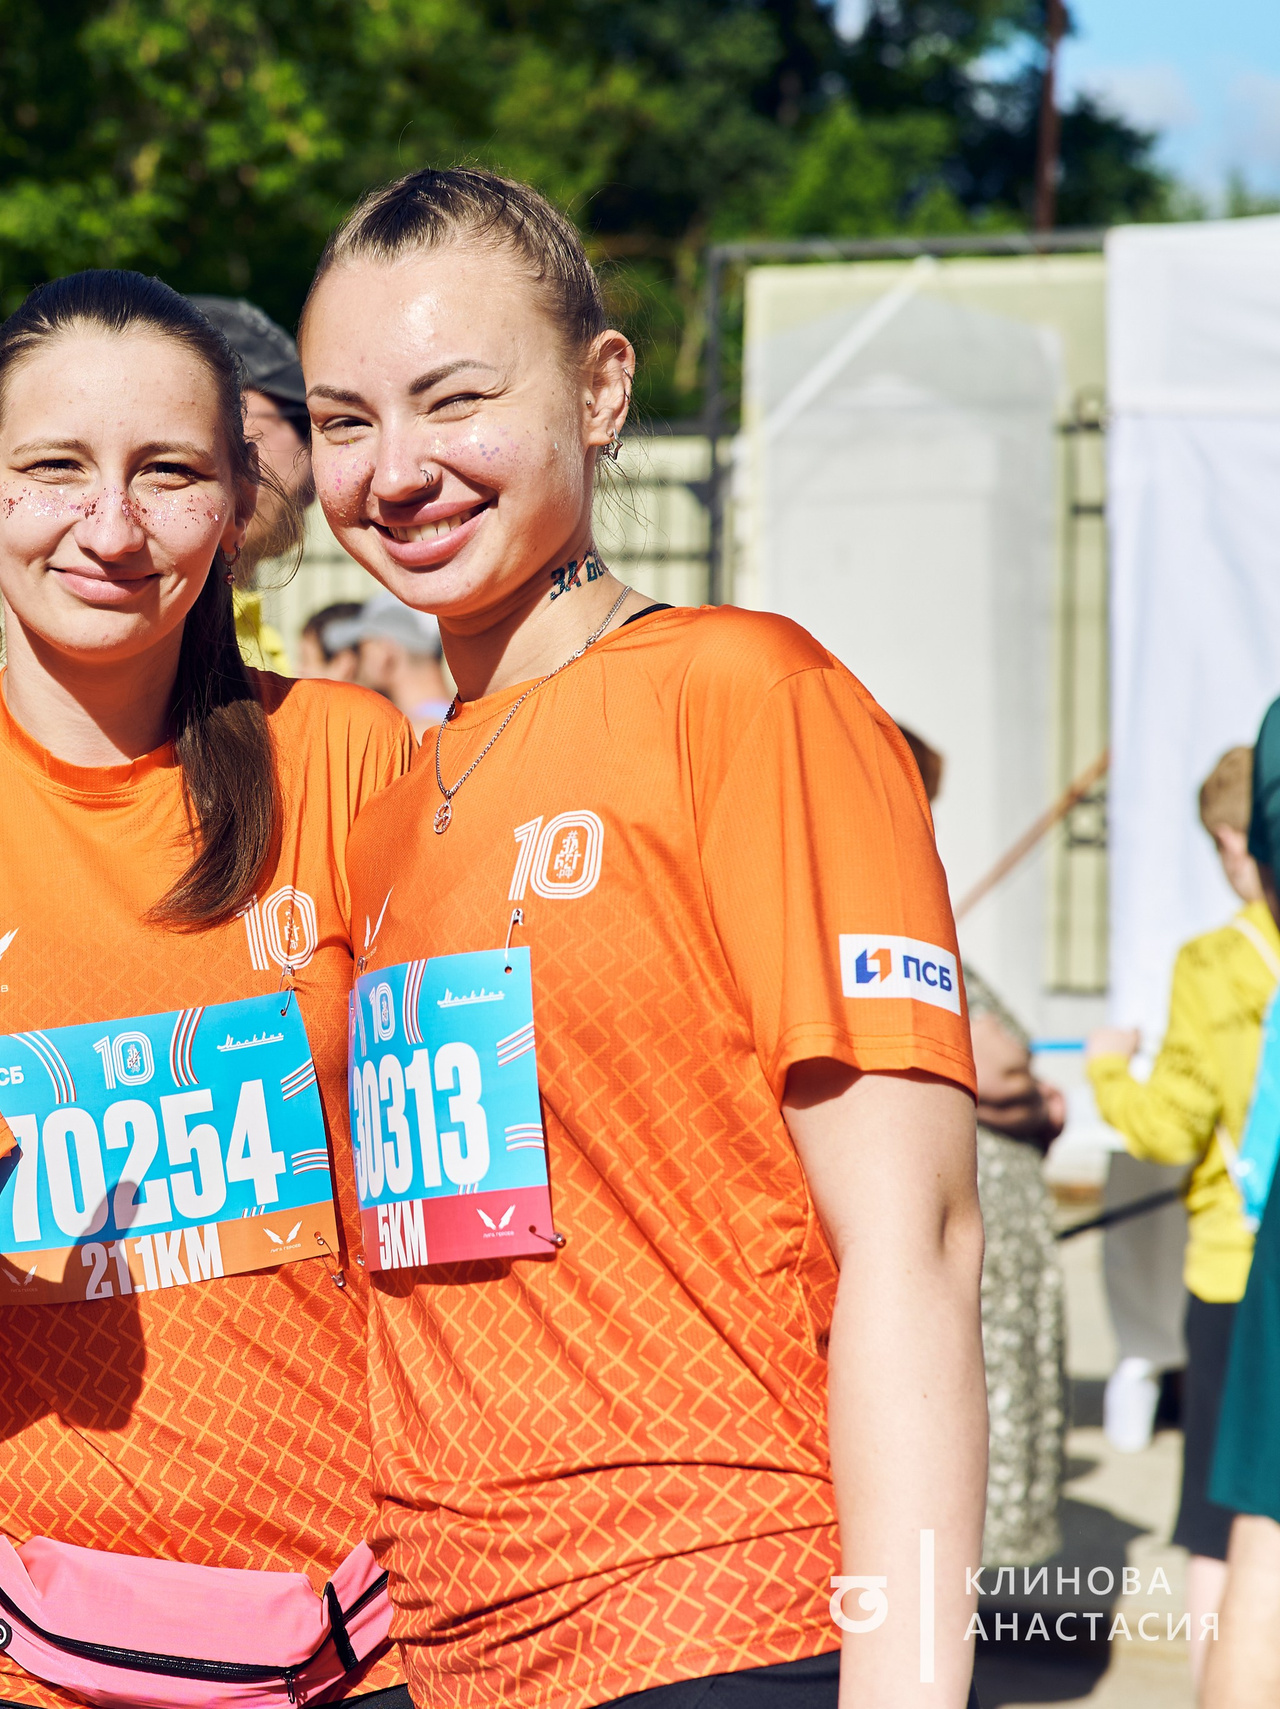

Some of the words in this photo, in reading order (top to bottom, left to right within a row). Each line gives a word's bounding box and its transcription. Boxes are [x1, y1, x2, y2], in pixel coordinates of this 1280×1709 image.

[507, 809, 604, 901] 10
[233, 885, 319, 971] 10
[369, 982, 396, 1044] 10
[902, 955, 952, 992] ПСБ
[92, 1030, 155, 1090] 10
[6, 1079, 287, 1243] 70254
[353, 1042, 491, 1202] 30313
